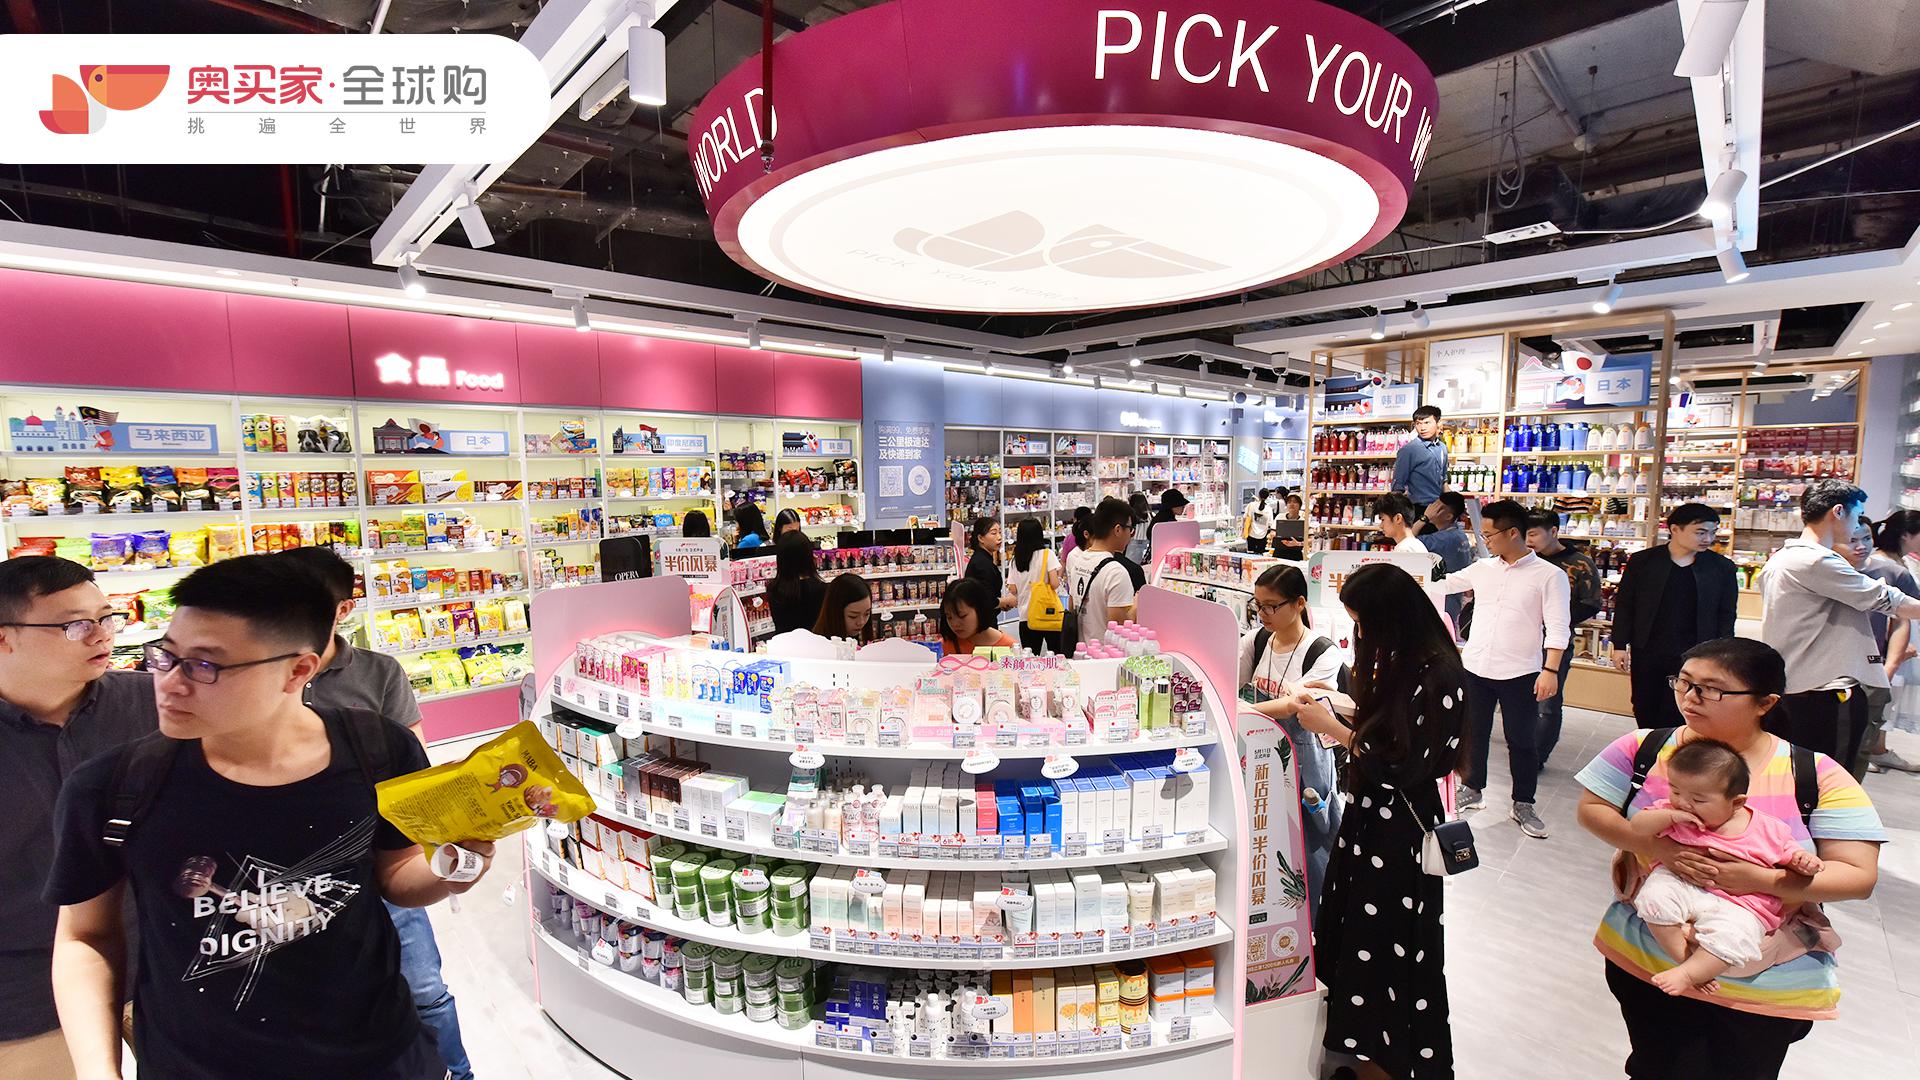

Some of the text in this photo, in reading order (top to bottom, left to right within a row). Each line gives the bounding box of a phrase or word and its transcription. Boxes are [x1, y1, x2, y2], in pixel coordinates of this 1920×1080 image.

[1095, 10, 1279, 93] PICK
[1305, 34, 1412, 144] YOUR
[694, 88, 777, 200] WORLD
[455, 369, 504, 391] Food
[1597, 377, 1631, 391] 日本
[135, 428, 206, 442] 马来西亚
[466, 435, 491, 446] 日本
[878, 436, 930, 448] 三公里极速达
[878, 448, 922, 460] 及快递到家
[664, 554, 718, 572] 半价风暴
[614, 570, 640, 581] OPERA
[1254, 763, 1269, 831] 新店开业
[257, 869, 265, 888] I
[1252, 836, 1268, 906] 半价风暴
[193, 873, 332, 918] BELIEVE
[249, 903, 285, 930] IN
[200, 911, 336, 956] DIGNITY
